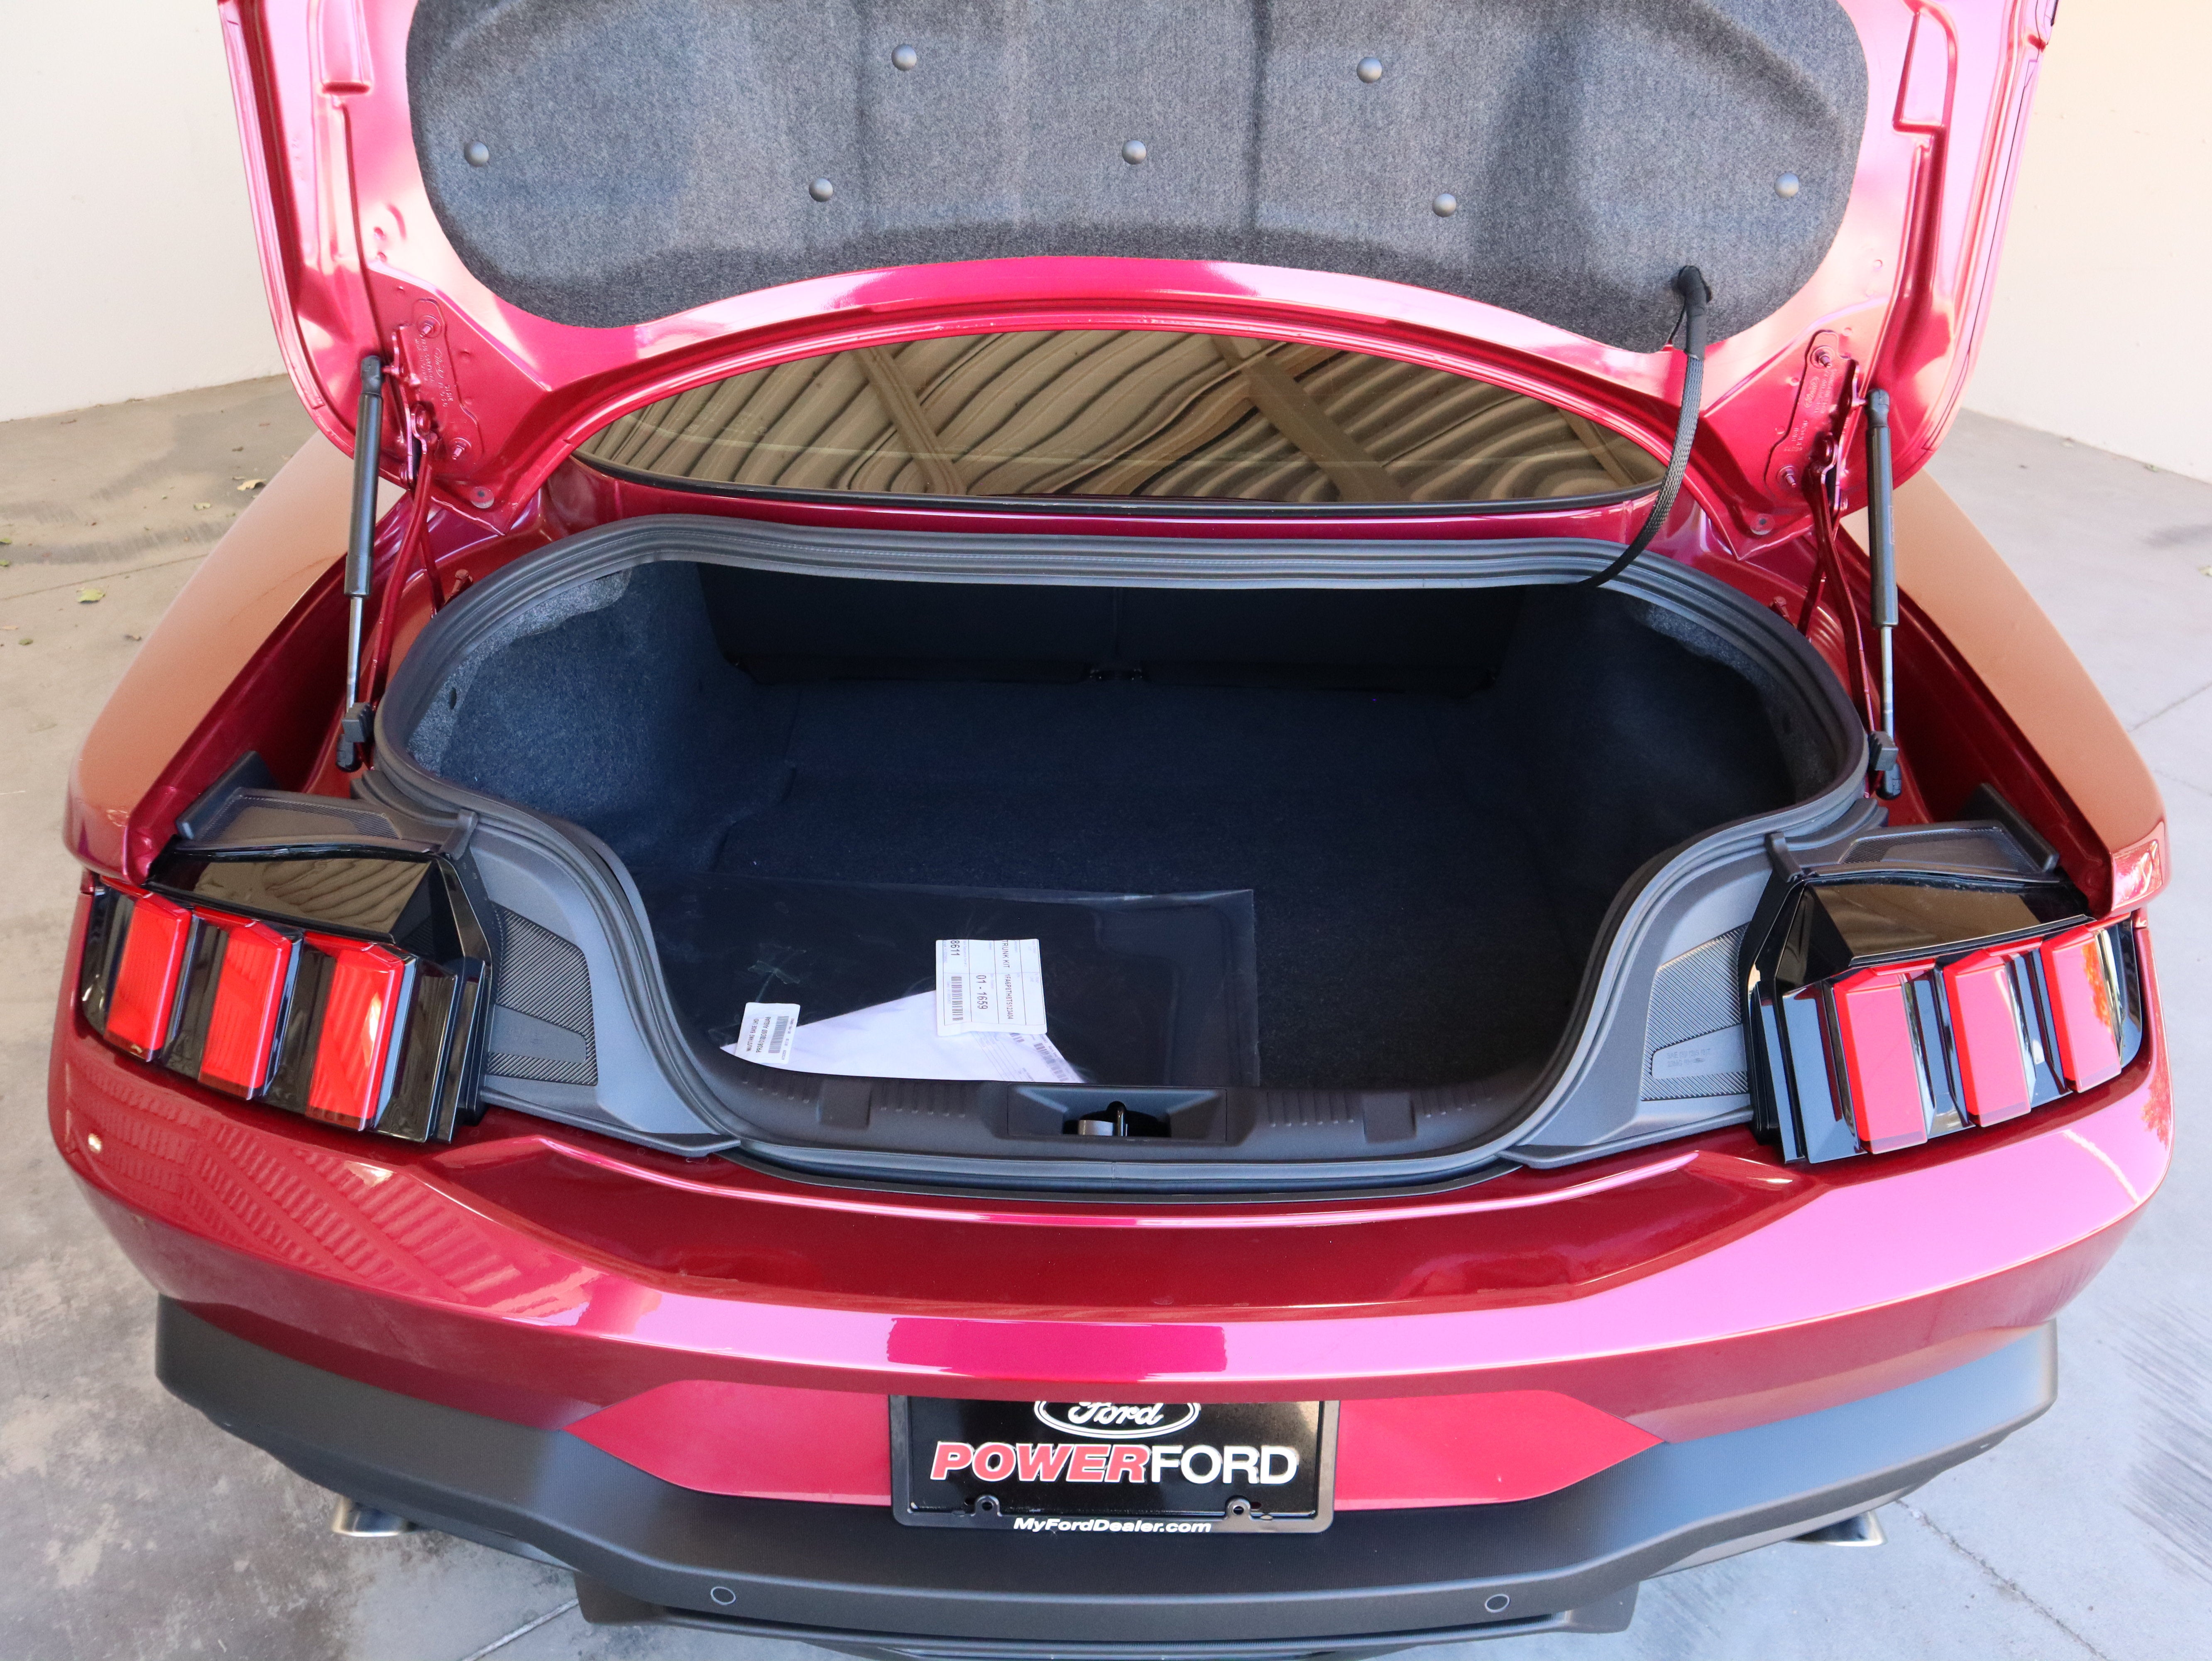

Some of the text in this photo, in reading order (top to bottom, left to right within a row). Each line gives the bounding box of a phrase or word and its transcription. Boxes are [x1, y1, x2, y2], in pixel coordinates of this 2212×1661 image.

[950, 940, 960, 955] 8611
[977, 992, 988, 1009] 1659
[746, 1034, 755, 1051] MUSTANG
[1068, 1401, 1164, 1425] Ford
[1013, 1517, 1212, 1532] MyFordDealer.com
